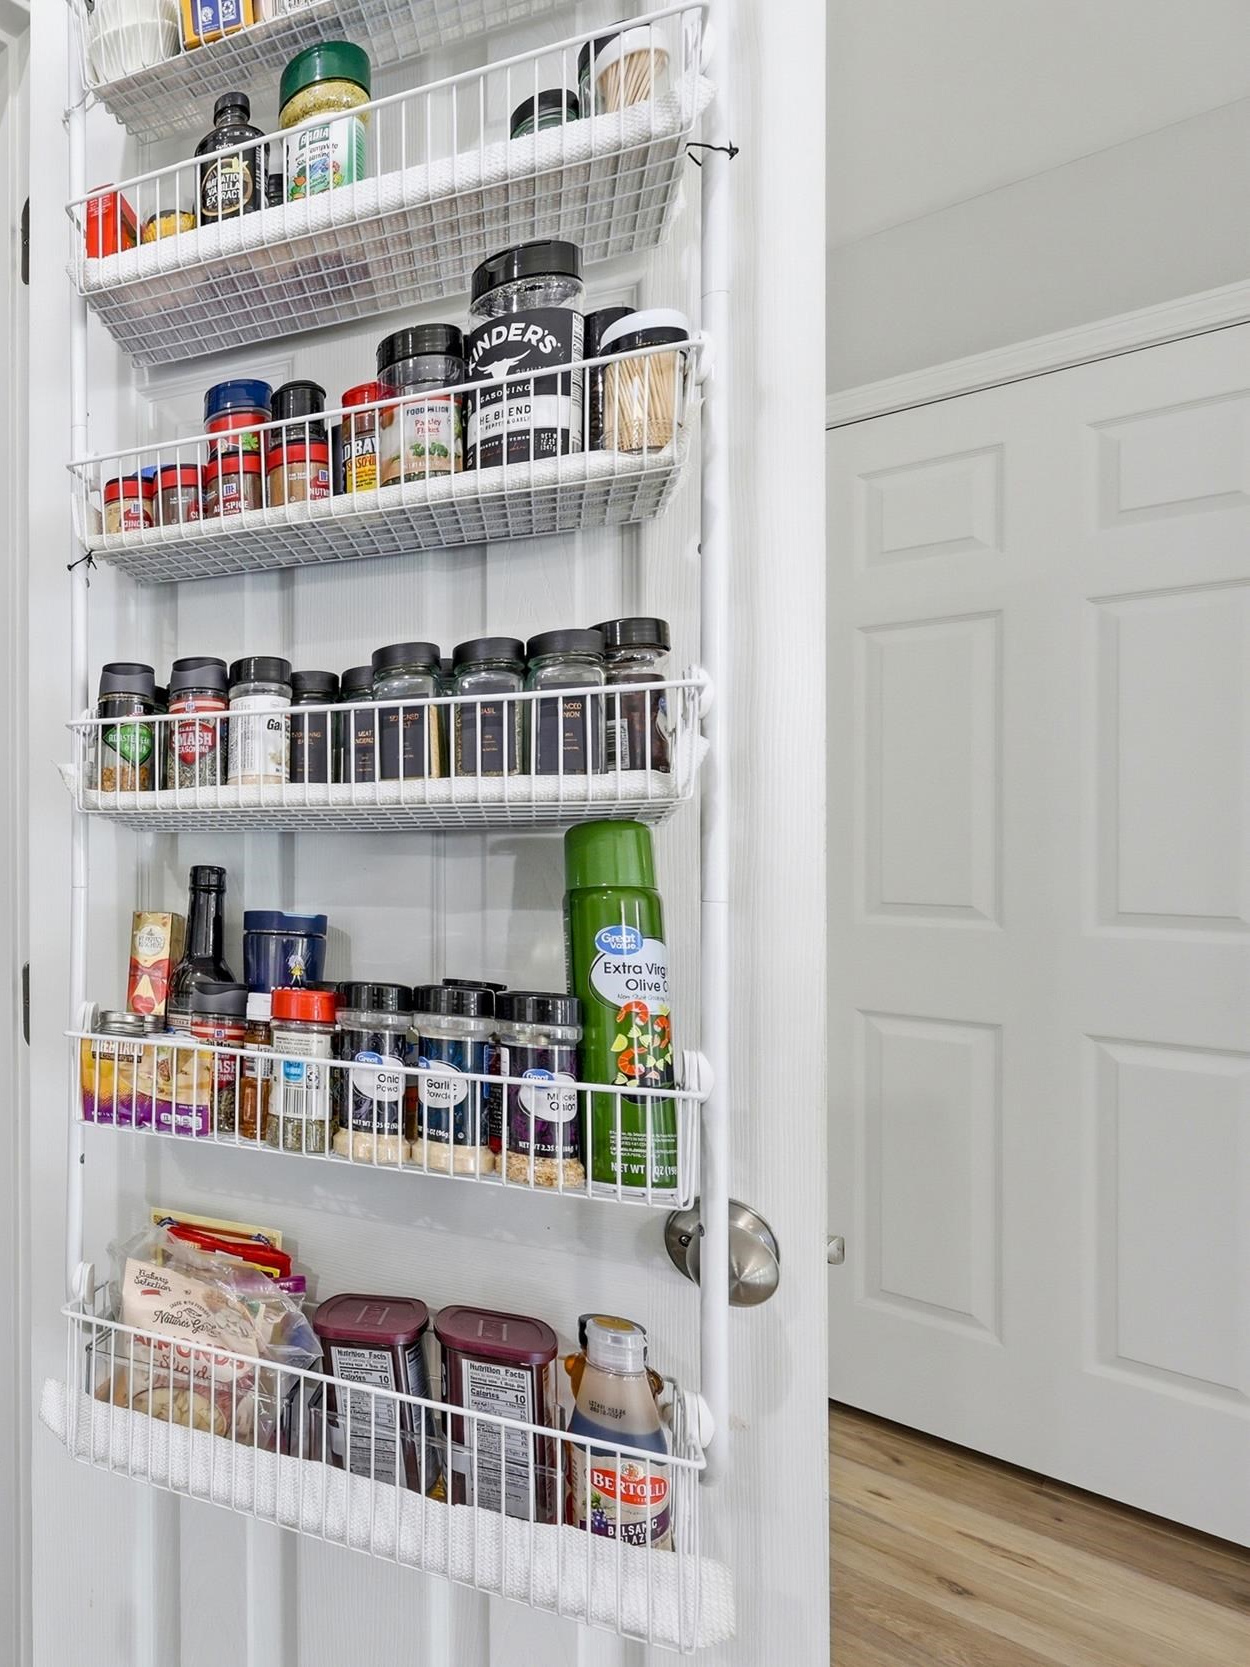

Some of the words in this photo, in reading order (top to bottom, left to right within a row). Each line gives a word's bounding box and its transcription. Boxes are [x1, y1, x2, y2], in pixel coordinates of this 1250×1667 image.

[406, 408, 424, 417] FOOD
[600, 931, 635, 943] Great
[610, 941, 636, 950] Value
[604, 962, 642, 975] Extra
[646, 964, 666, 979] Virg
[625, 979, 661, 992] Olive
[152, 1309, 190, 1329] Nature's
[337, 1349, 365, 1358] Nutrition
[368, 1352, 387, 1361] Facts
[469, 1363, 500, 1375] Nutrition
[504, 1367, 526, 1380] Facts
[340, 1373, 367, 1382] Calories
[378, 1376, 389, 1384] 10
[470, 1387, 500, 1399] Calories
[514, 1393, 527, 1404] 10
